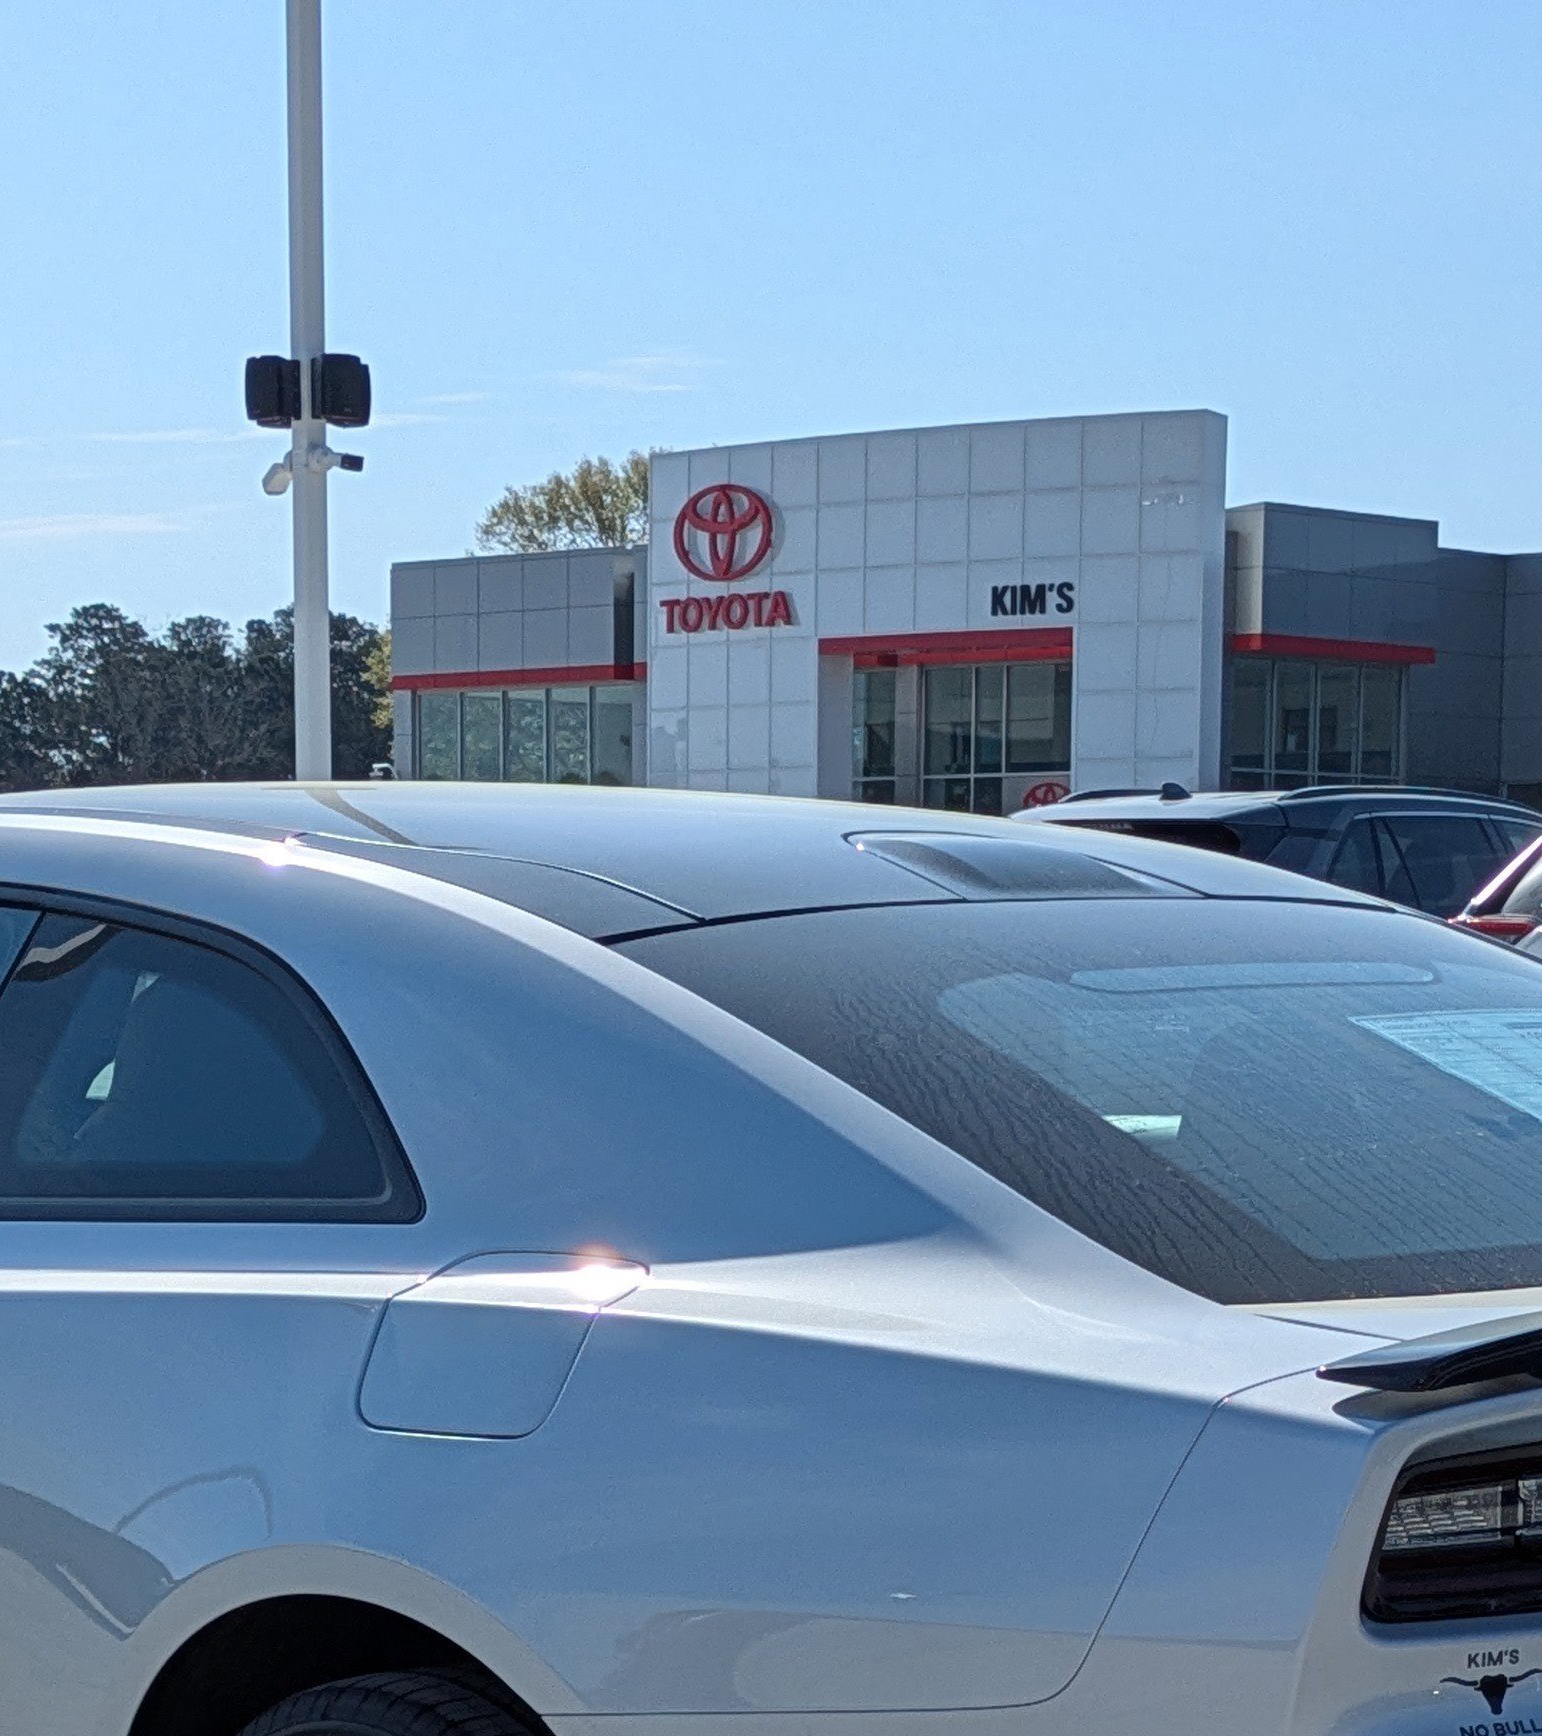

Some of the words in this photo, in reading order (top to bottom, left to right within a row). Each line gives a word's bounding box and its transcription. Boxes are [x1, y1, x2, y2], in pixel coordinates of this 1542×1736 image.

[659, 590, 793, 634] TOYOTA
[990, 582, 1075, 617] KIM'S
[1467, 1649, 1520, 1669] KIM'S
